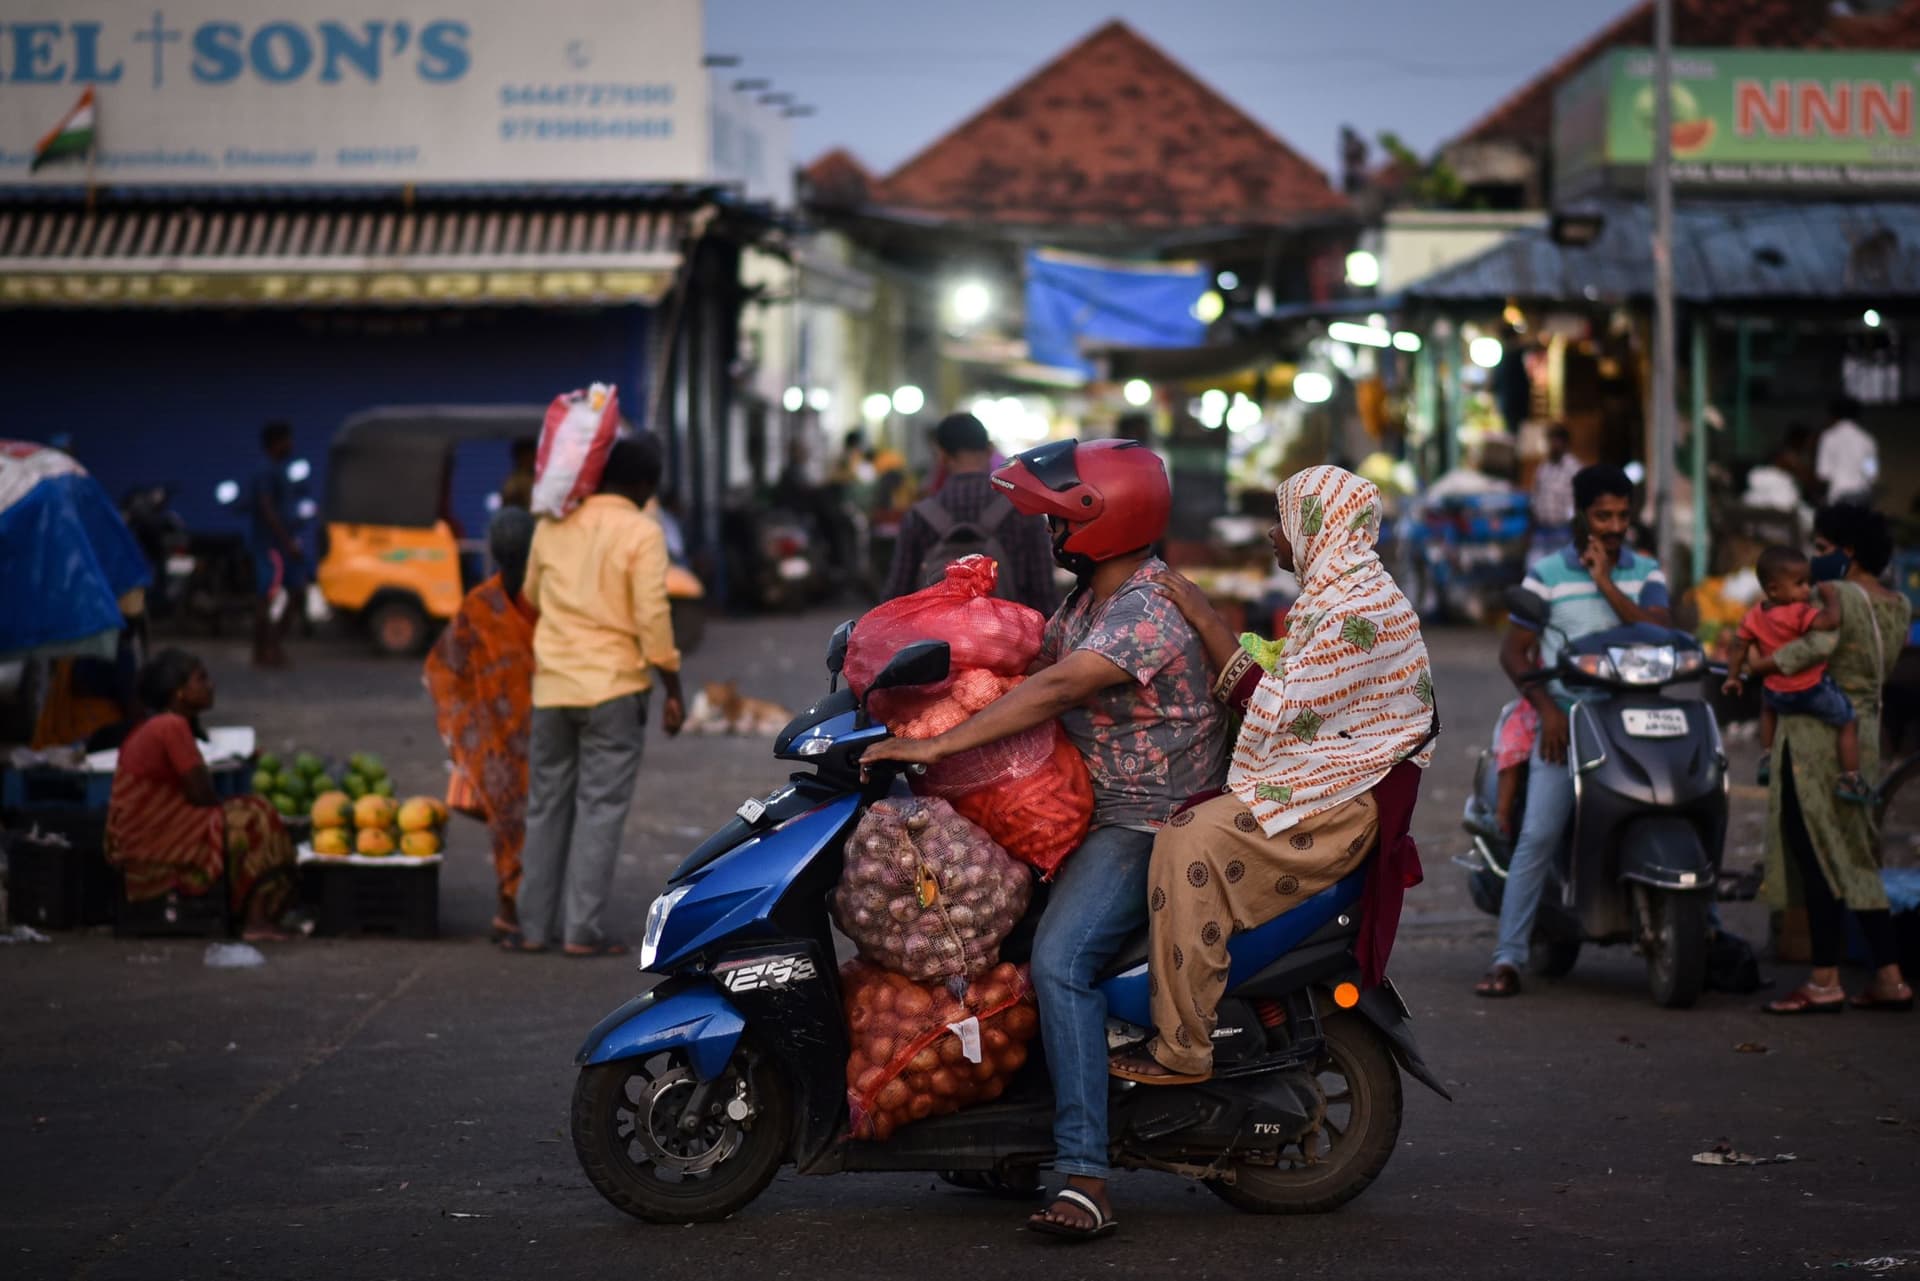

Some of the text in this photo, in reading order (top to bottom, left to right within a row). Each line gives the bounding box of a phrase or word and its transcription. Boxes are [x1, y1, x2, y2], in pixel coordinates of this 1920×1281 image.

[0, 19, 473, 86] EL SON'S
[1735, 80, 1914, 138] NNN
[1253, 1122, 1281, 1135] TVS
